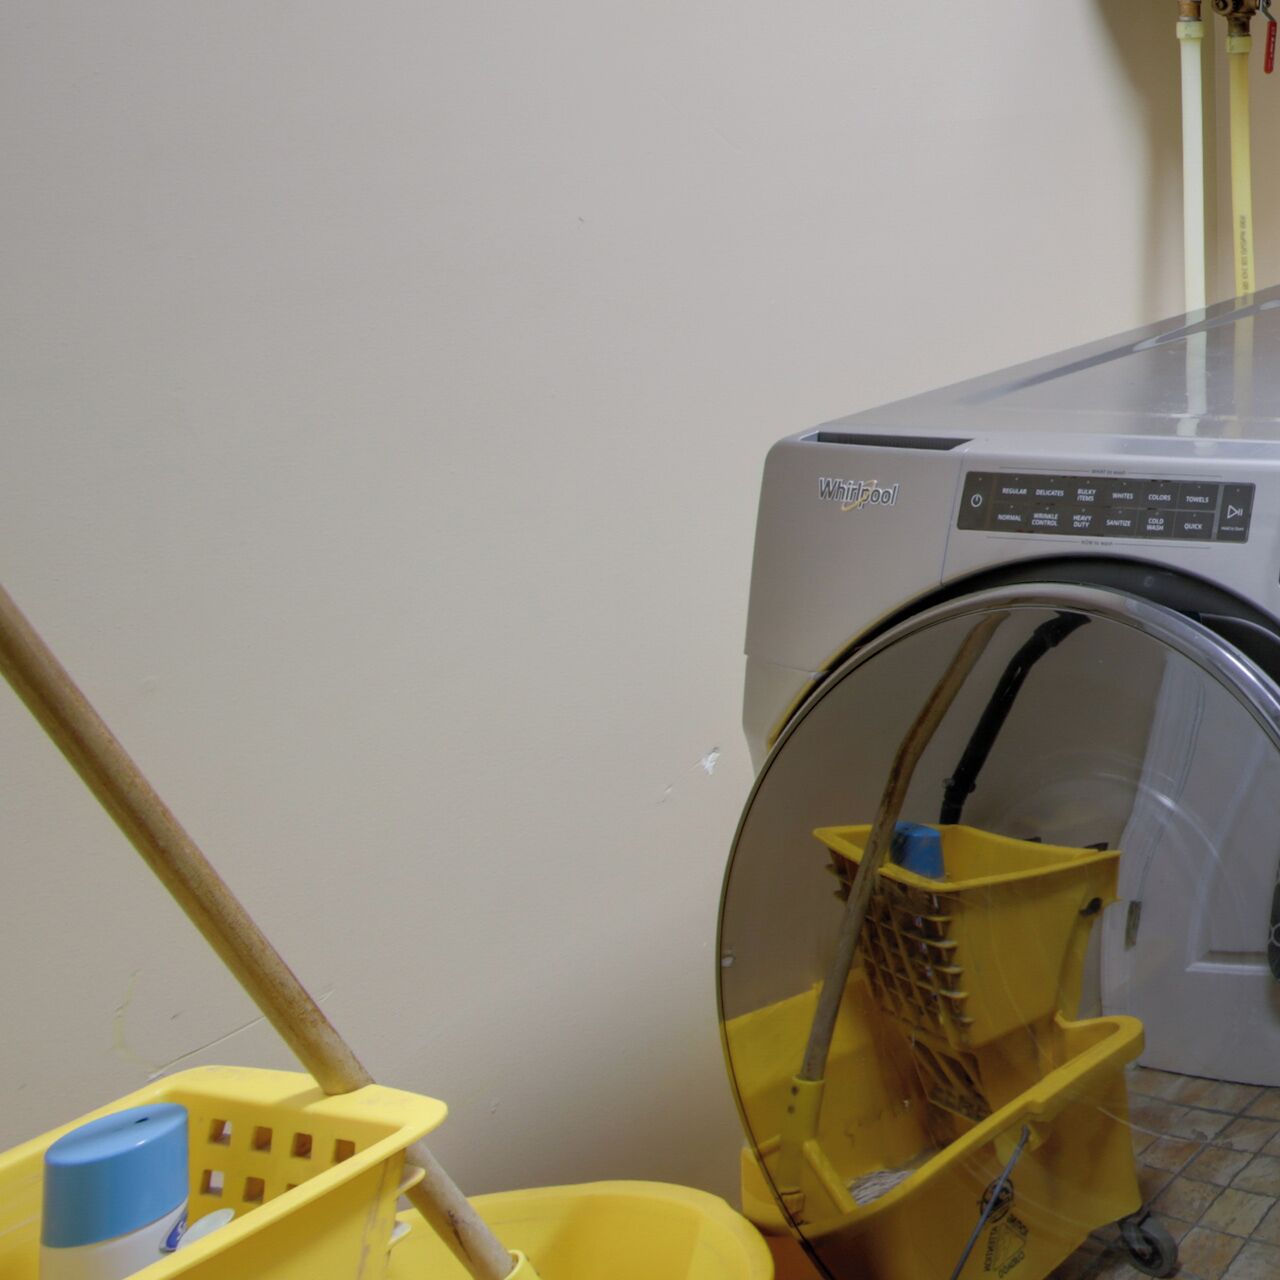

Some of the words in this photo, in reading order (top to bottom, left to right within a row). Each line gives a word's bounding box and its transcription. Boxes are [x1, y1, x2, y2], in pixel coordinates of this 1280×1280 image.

[818, 478, 899, 509] Whirlpool
[1036, 489, 1064, 497] DELICATES
[1077, 488, 1096, 496] BULKY
[1112, 492, 1134, 500] WHITES
[1148, 494, 1172, 502] COLORS
[998, 514, 1022, 522] NORMAL
[1184, 522, 1202, 530] QUICK
